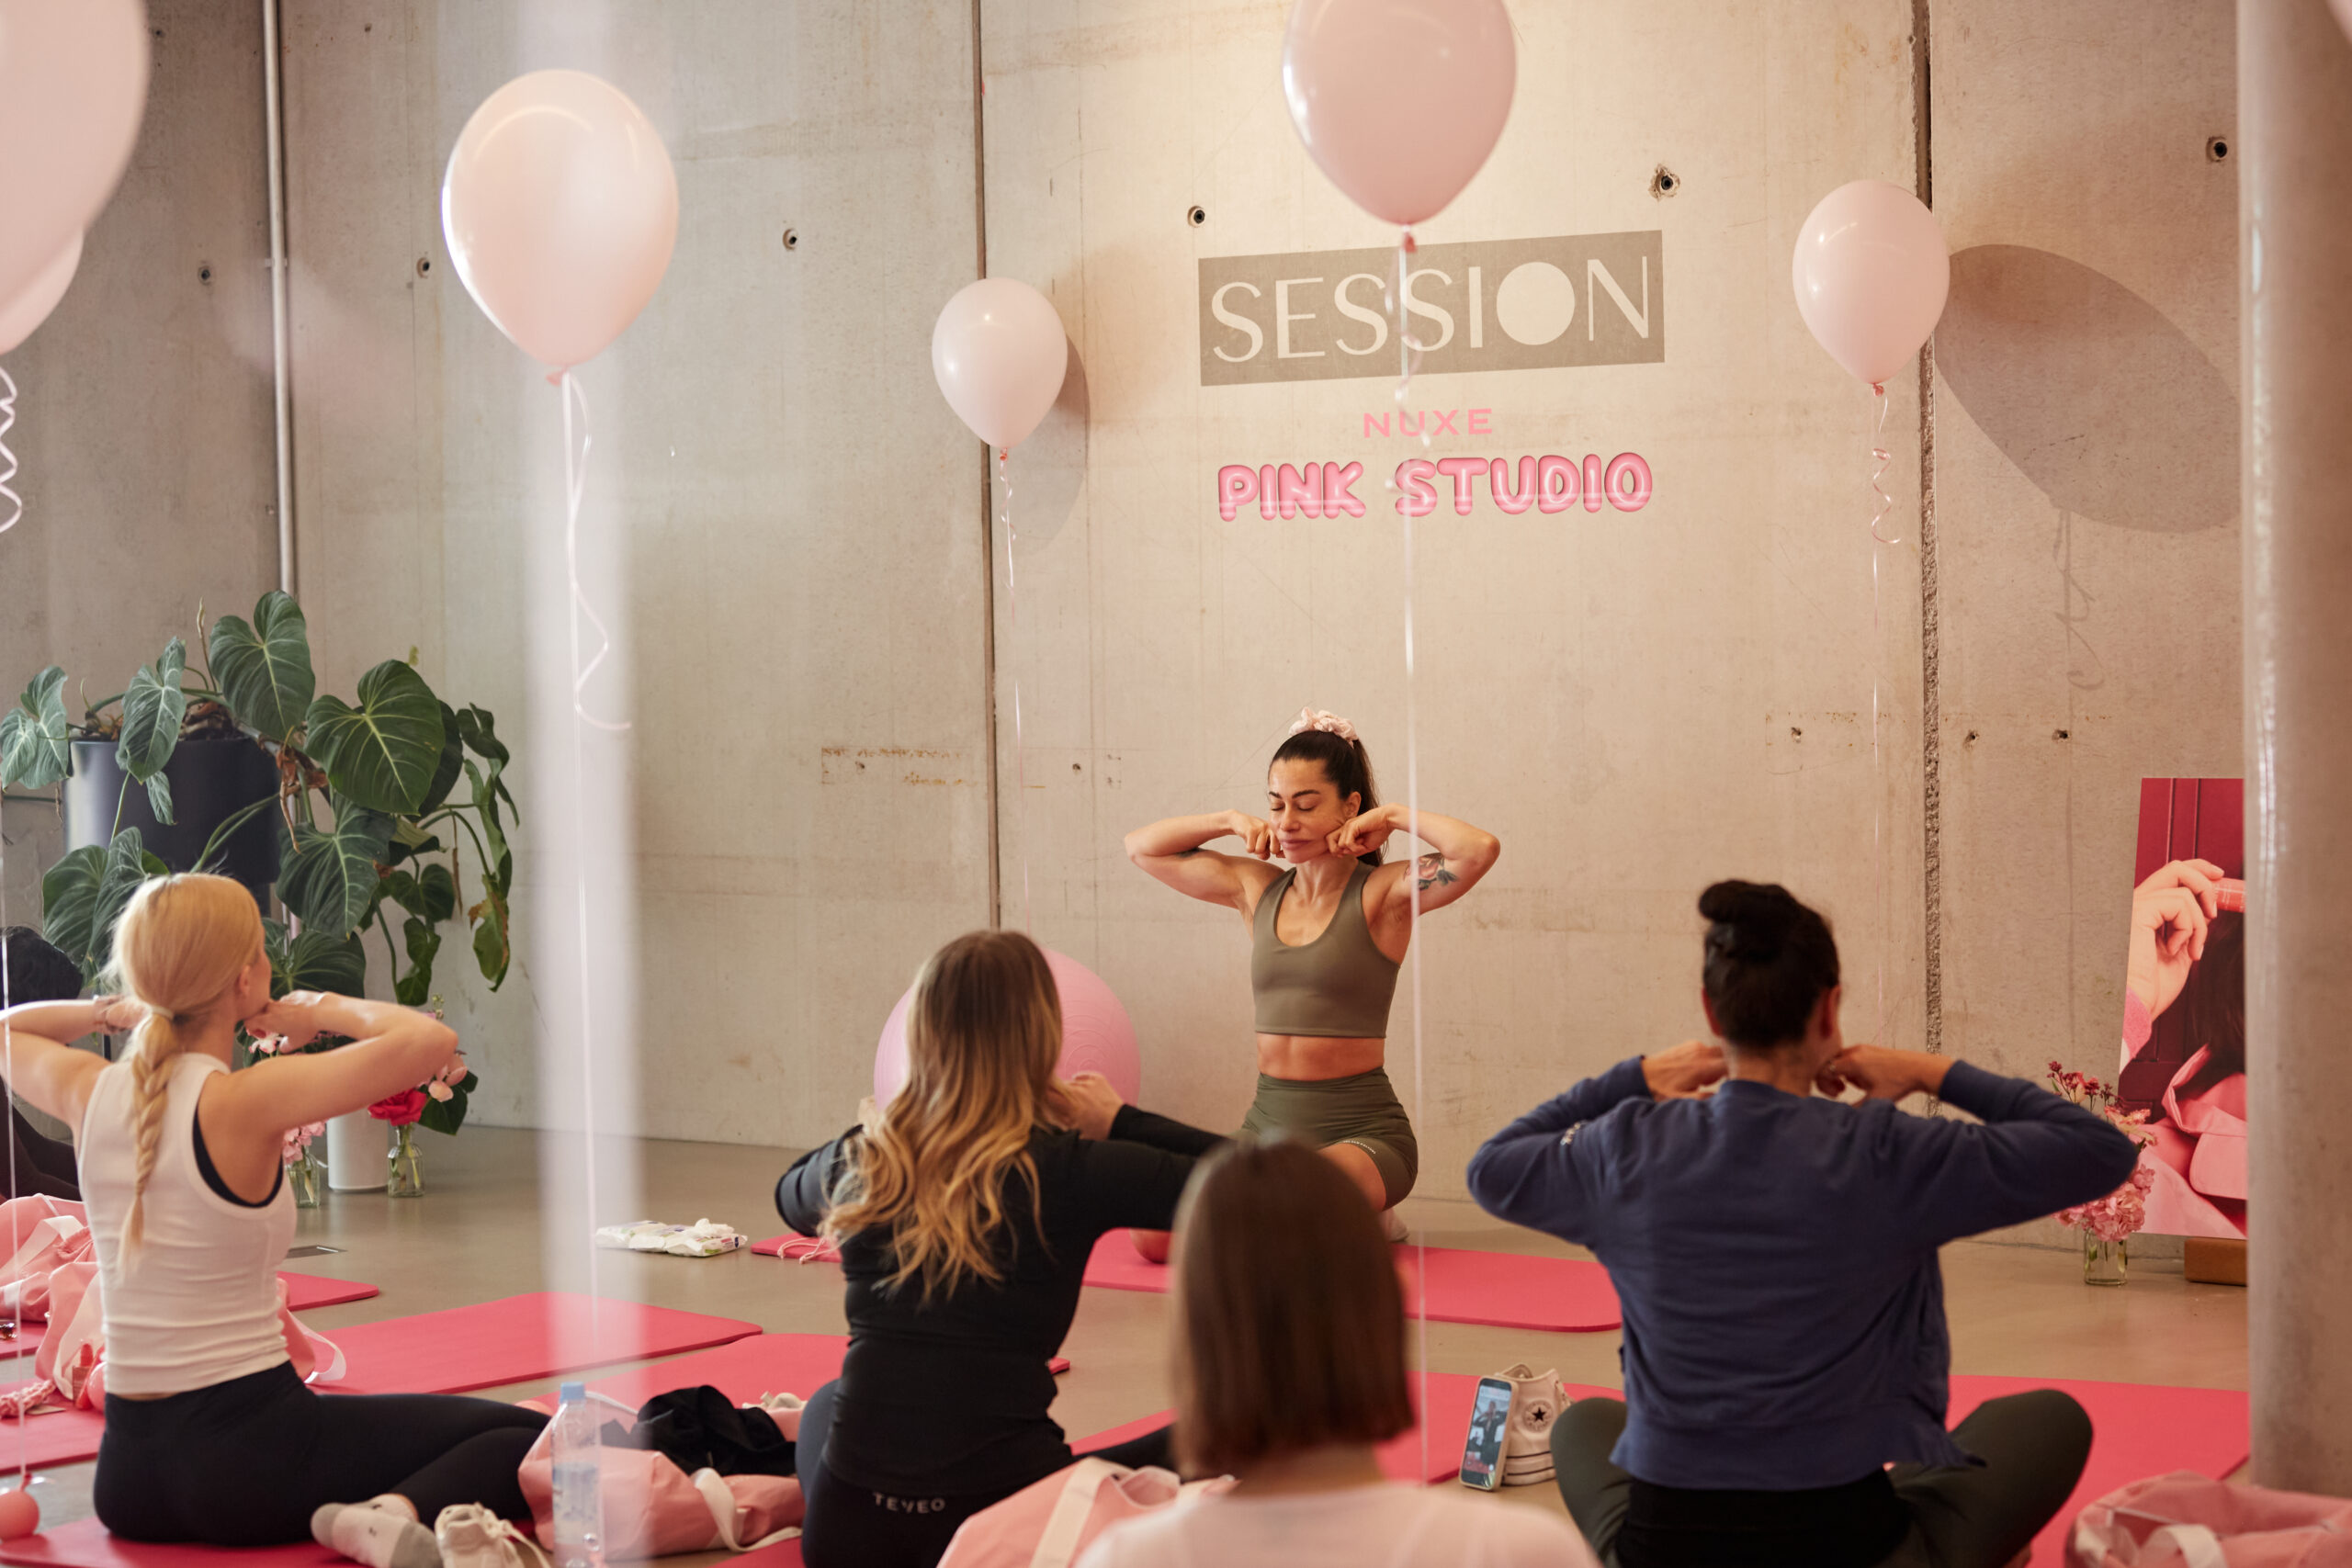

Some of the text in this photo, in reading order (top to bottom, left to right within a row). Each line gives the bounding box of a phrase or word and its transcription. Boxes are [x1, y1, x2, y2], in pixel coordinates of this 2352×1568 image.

[1211, 255, 1649, 363] SESSION
[1363, 407, 1493, 439] NUXE
[1218, 451, 1654, 522] PINK STUDIO
[873, 1492, 945, 1514] TEVEO
